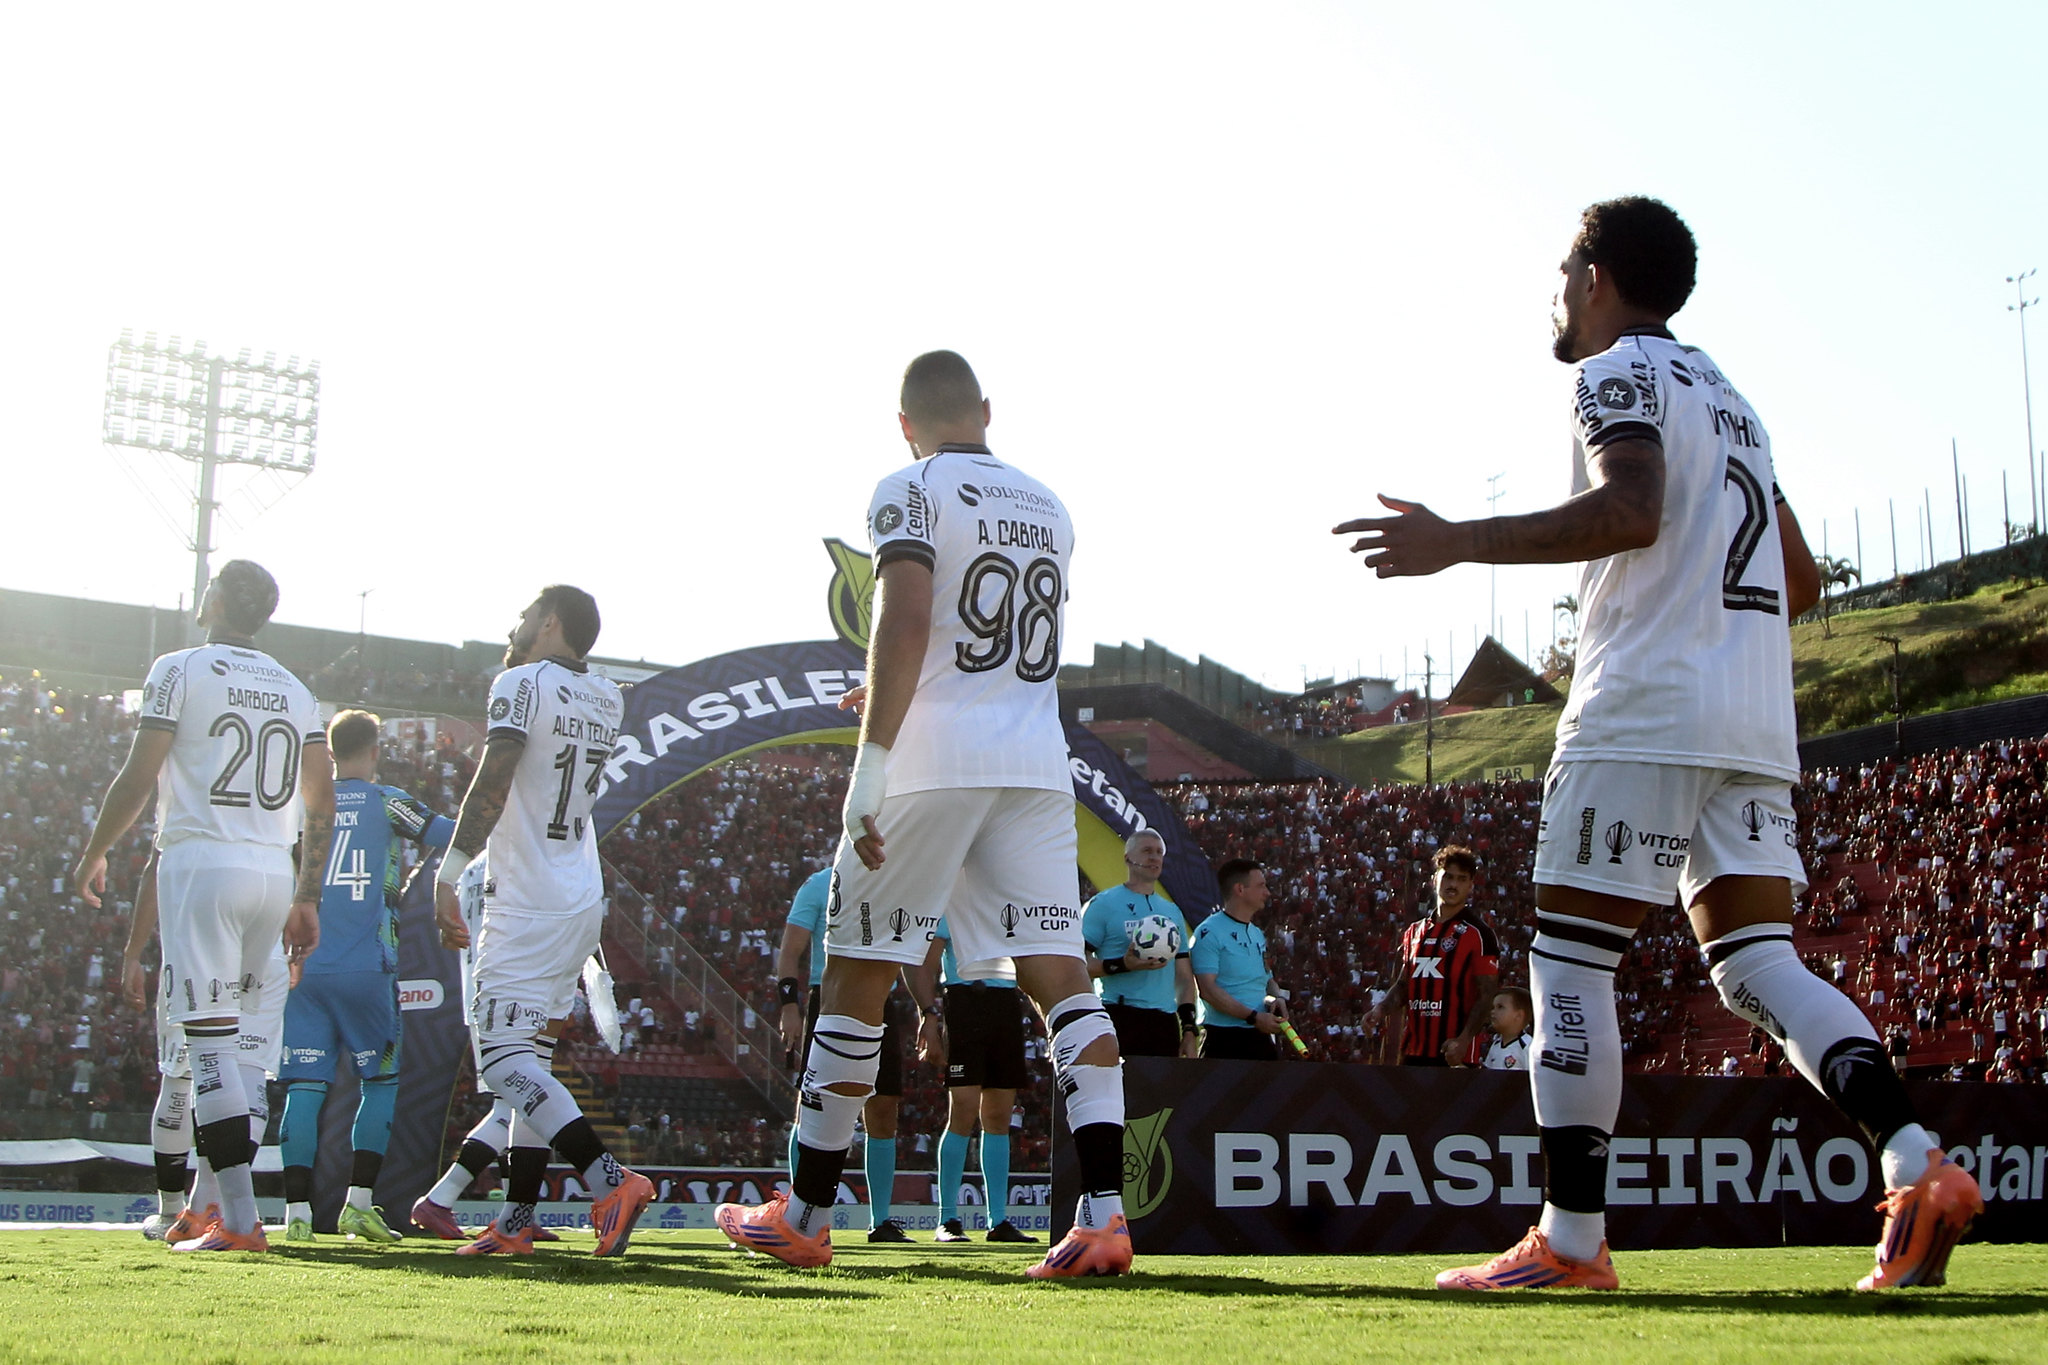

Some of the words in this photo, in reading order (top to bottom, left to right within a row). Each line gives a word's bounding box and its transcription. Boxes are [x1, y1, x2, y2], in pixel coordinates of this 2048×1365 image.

[983, 486, 1056, 509] SOLUTIONS
[978, 519, 993, 545] A.
[998, 519, 1059, 555] CABRAL
[1723, 455, 1780, 615] 2
[955, 551, 1062, 682] 98
[153, 665, 180, 715] Centrum
[228, 687, 289, 713] BARBOZA
[553, 715, 584, 740] ALEX
[587, 721, 621, 748] TELLE
[208, 712, 301, 810] 20
[1495, 767, 1523, 781] BAR
[336, 791, 367, 800] TIONS
[1069, 757, 1163, 840] etan
[335, 811, 359, 827] NCK
[389, 797, 426, 826] Centrum
[1639, 831, 1689, 851] VITÓR
[1023, 904, 1079, 920] VITÓRIA
[1040, 920, 1069, 930] CUP
[1411, 957, 1445, 978] 7K
[399, 989, 434, 1004] ano
[292, 1048, 326, 1057] VITÓRIA
[1214, 1118, 1870, 1207] BRASIEIRÃO
[25, 1203, 95, 1221] exames
[540, 1210, 574, 1227] seus
